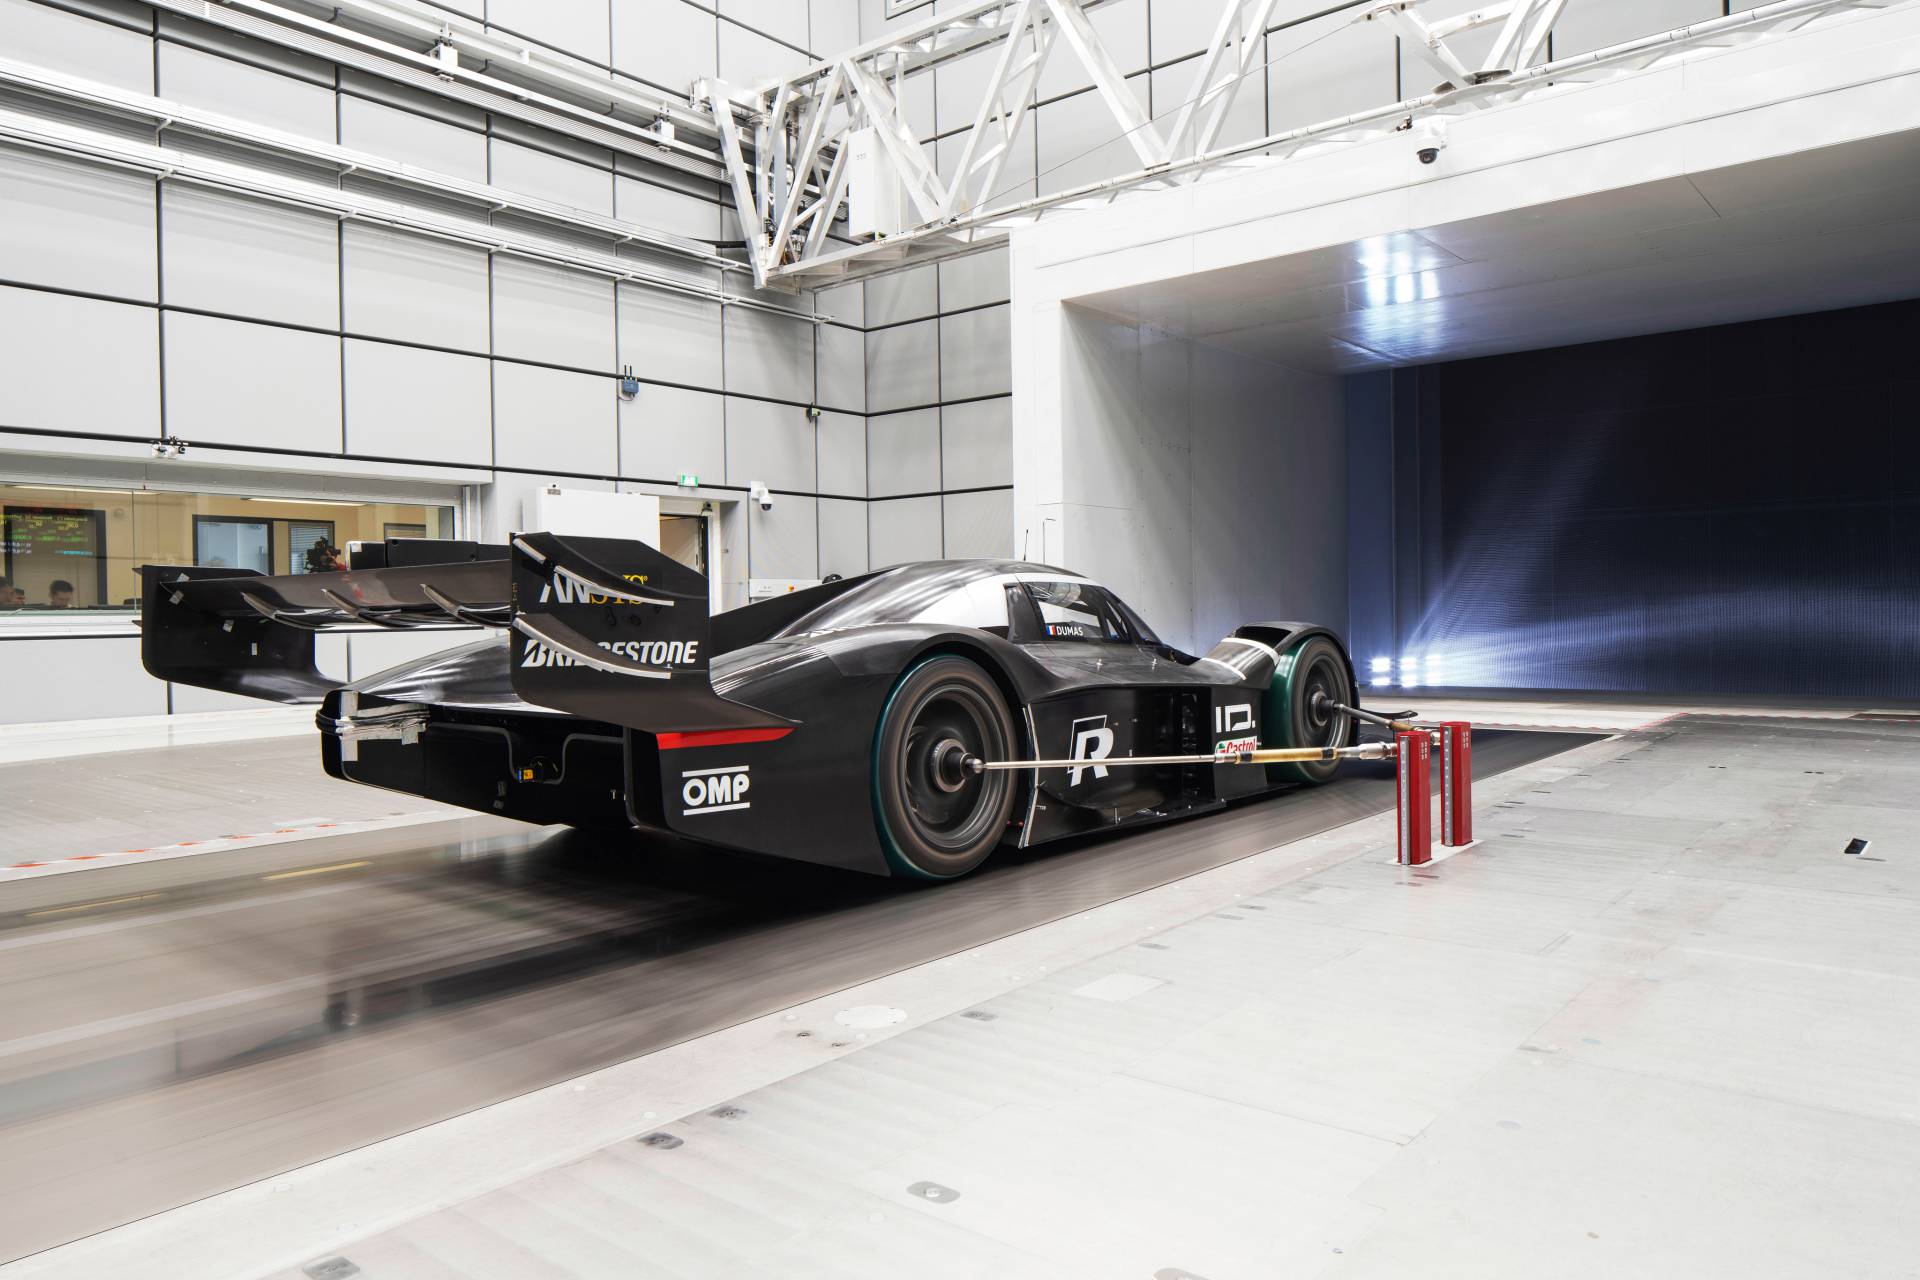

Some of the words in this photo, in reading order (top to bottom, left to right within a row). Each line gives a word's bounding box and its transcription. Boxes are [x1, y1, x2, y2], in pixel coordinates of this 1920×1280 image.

[1056, 626, 1084, 636] DUMAS
[521, 640, 698, 667] BRESTONE
[1067, 714, 1114, 787] R
[682, 773, 750, 806] OMP
